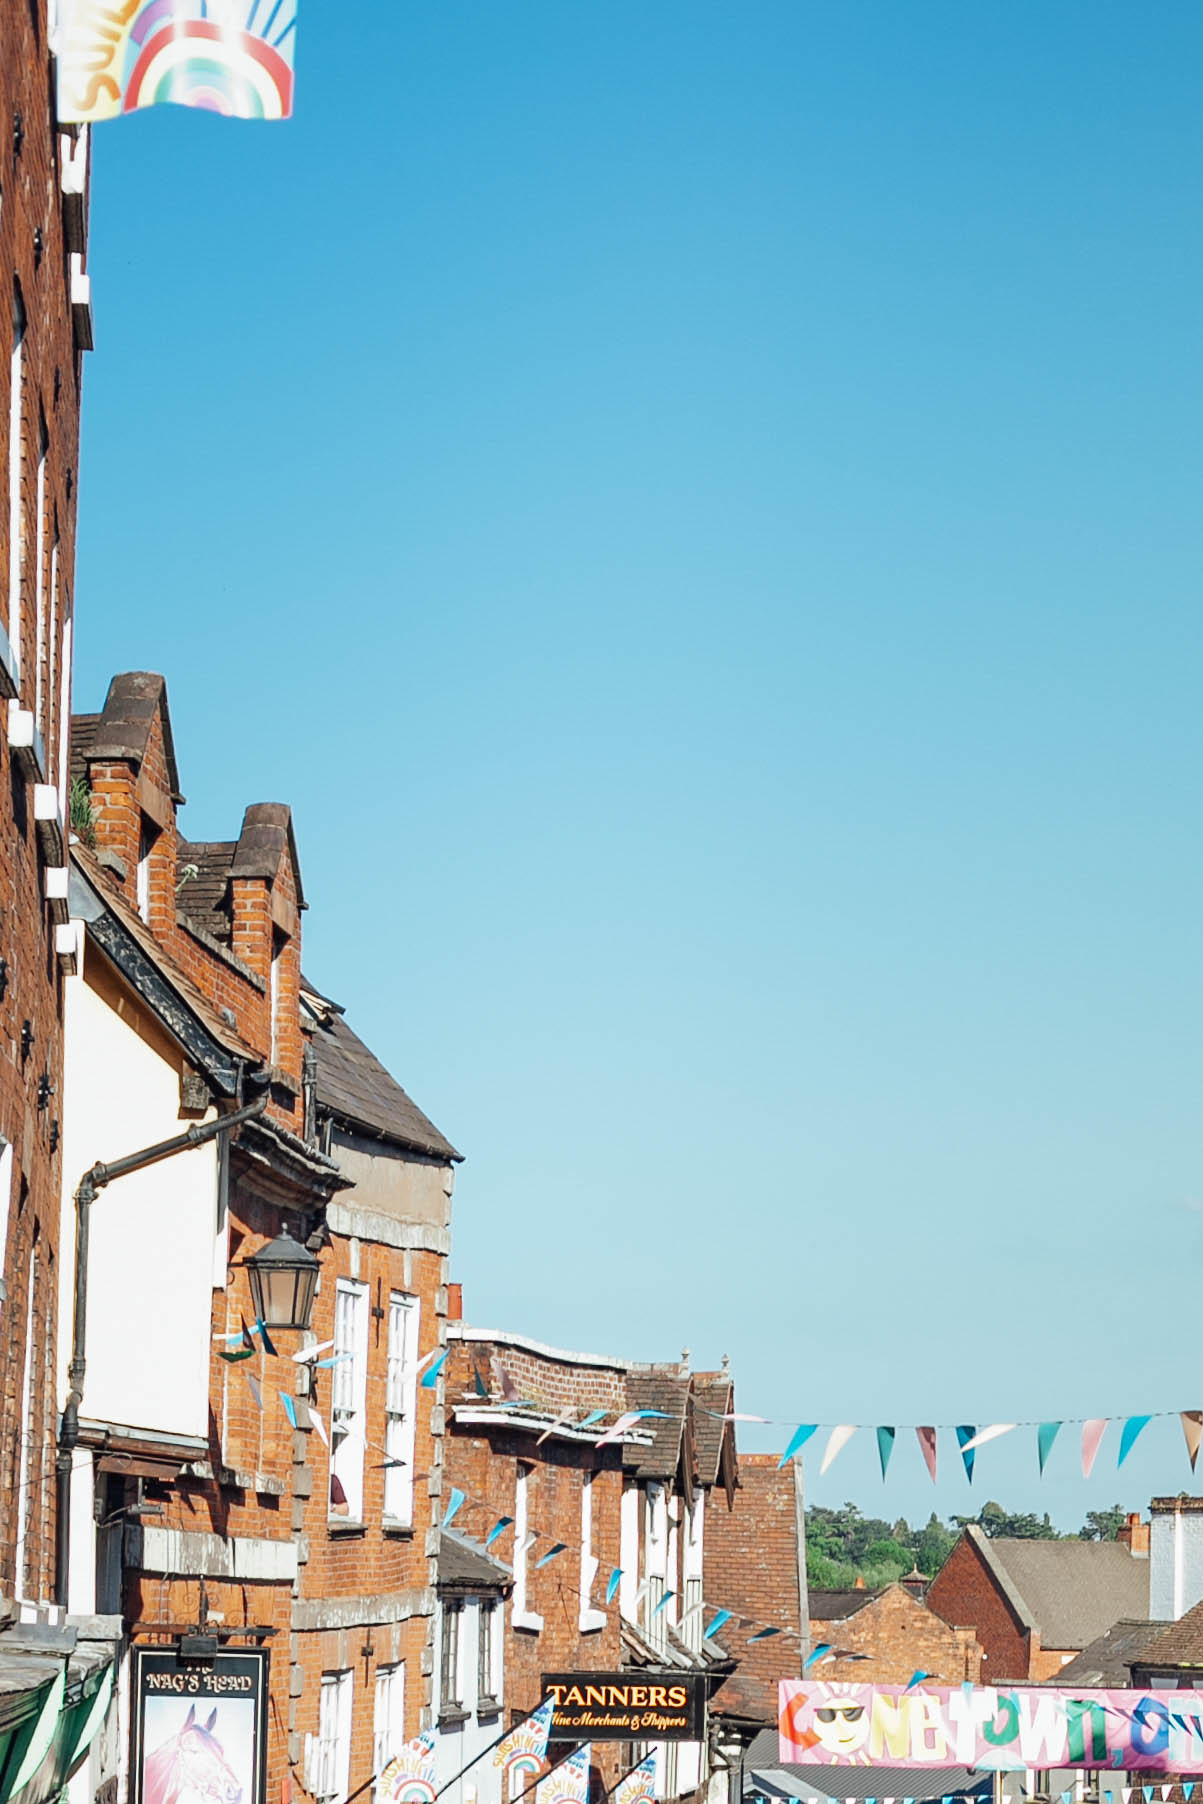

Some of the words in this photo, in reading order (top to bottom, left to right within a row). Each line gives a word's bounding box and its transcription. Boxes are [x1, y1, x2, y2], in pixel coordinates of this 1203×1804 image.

[146, 1674, 199, 1692] NAG'S
[546, 1685, 687, 1707] TANNERS
[572, 1712, 629, 1727] Merchants
[631, 1715, 640, 1730] &
